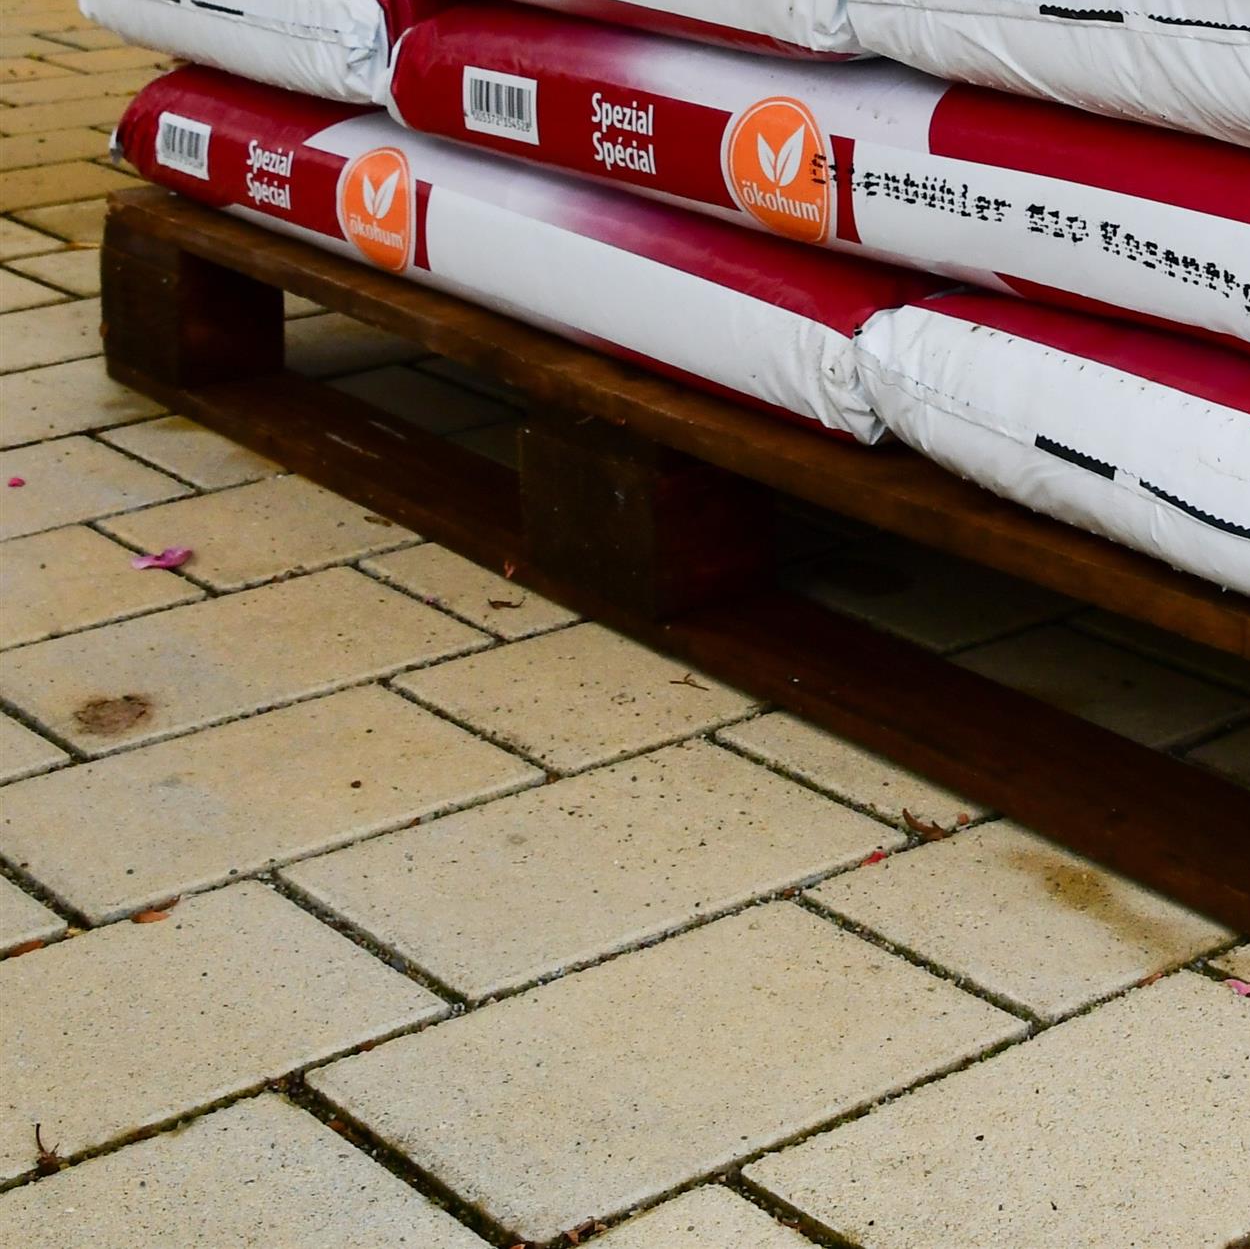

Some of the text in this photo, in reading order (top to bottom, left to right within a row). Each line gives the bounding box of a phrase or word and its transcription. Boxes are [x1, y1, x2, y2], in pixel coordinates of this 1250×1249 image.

[591, 92, 654, 137] Spezial
[246, 139, 295, 178] Spezial
[592, 134, 657, 175] Spécial
[246, 172, 291, 210] Spécial
[742, 179, 821, 224] ökohum
